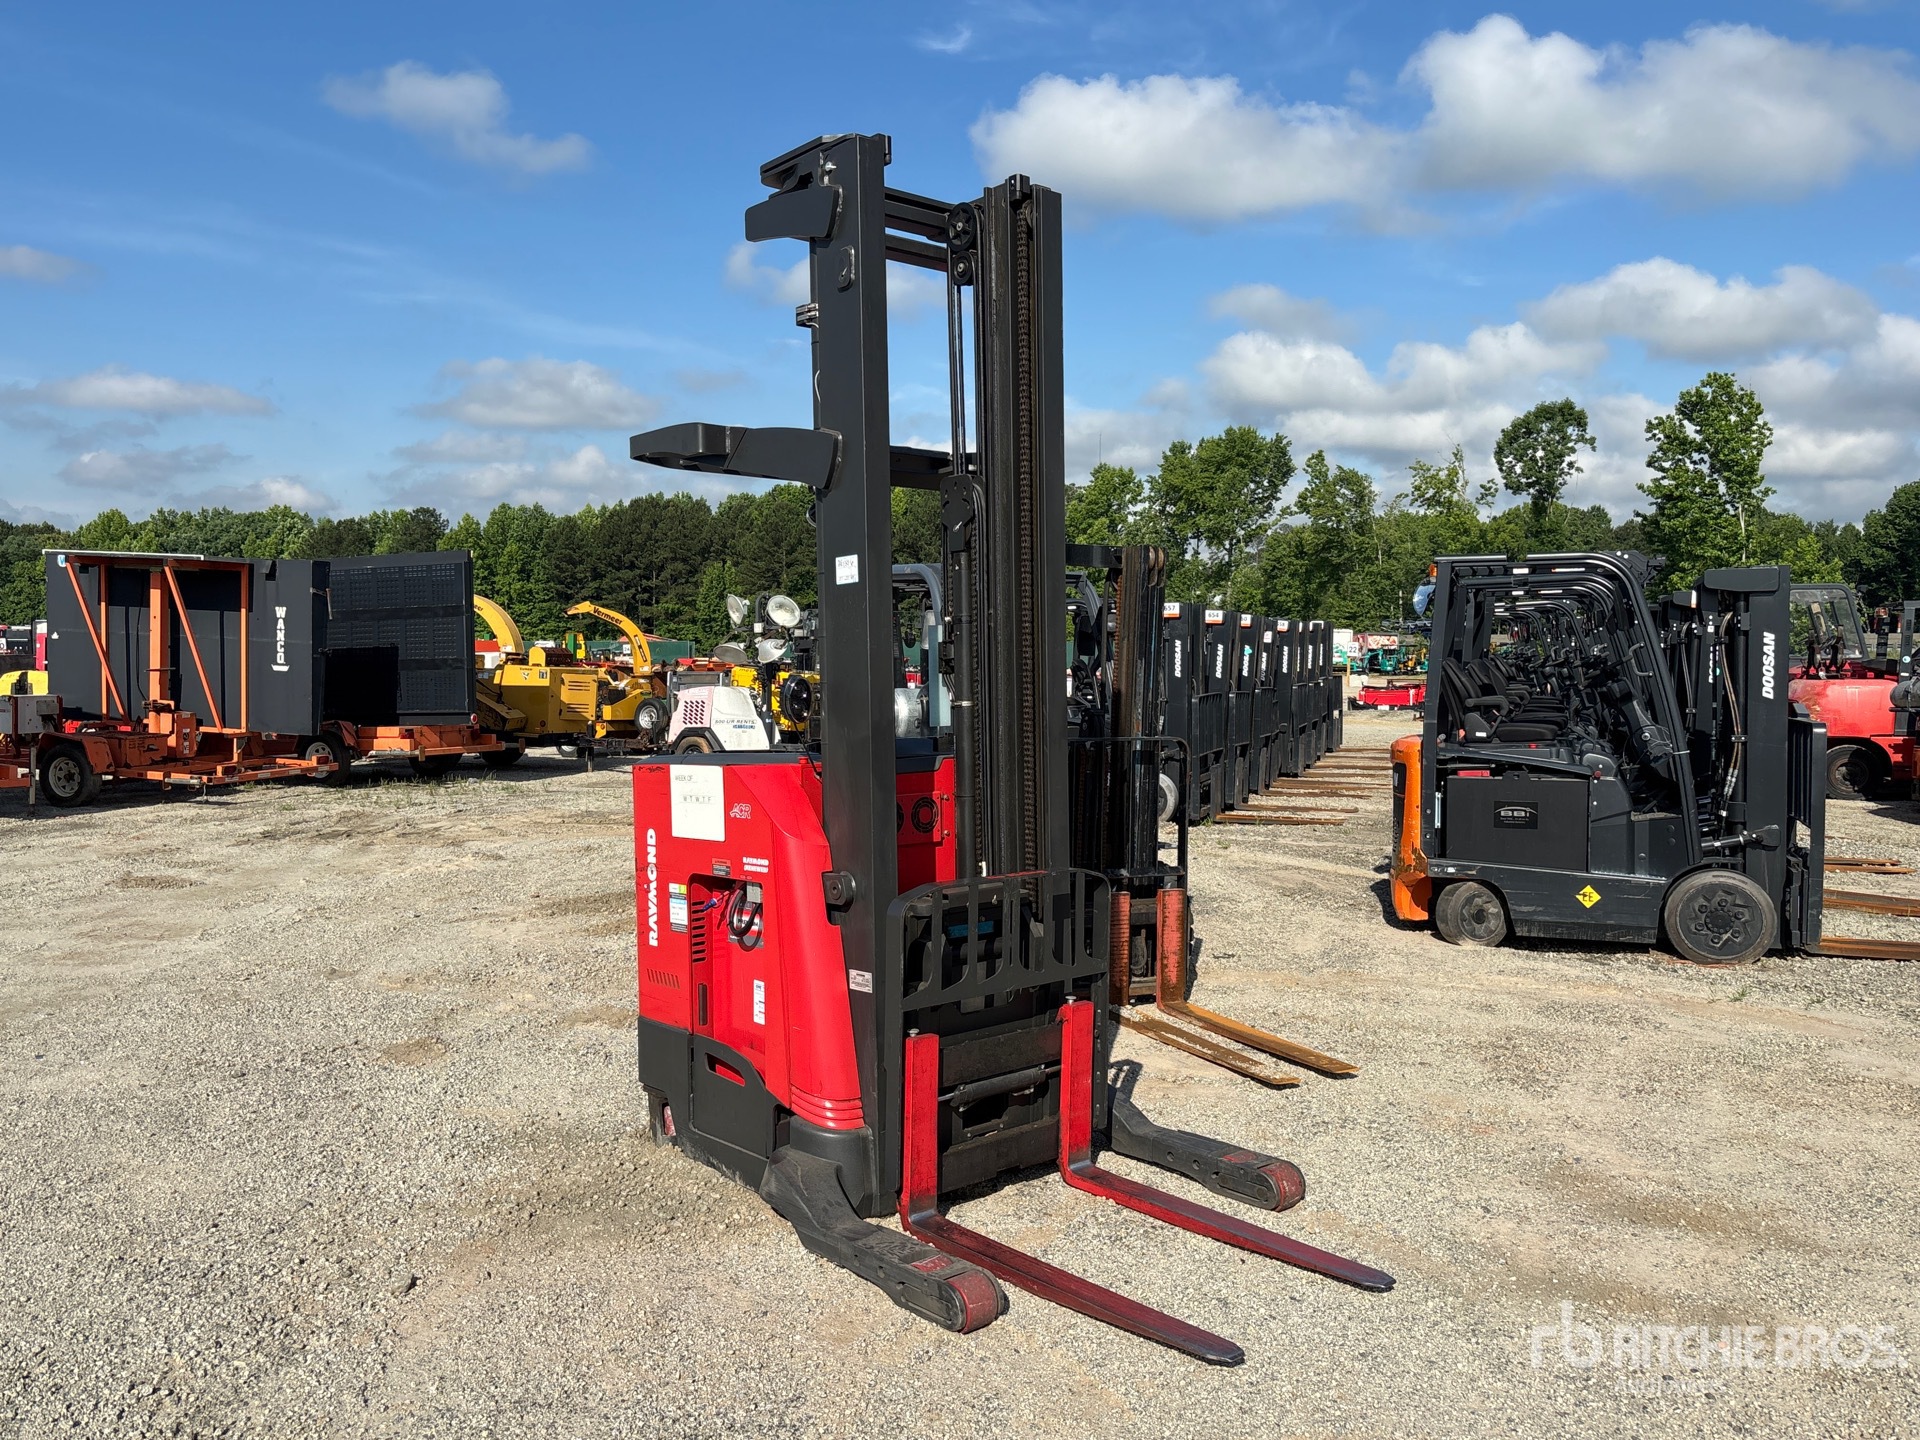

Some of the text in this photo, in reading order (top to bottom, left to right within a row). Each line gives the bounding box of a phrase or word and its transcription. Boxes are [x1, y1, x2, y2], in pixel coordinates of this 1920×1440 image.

[275, 606, 286, 664] WANCO
[593, 606, 623, 625] Vermeer
[1174, 639, 1182, 678] DOOSAN
[1216, 644, 1224, 678] DOOSAN
[1762, 631, 1776, 700] DOOSAN
[730, 803, 752, 819] ACR
[645, 828, 658, 947] RAYMOND
